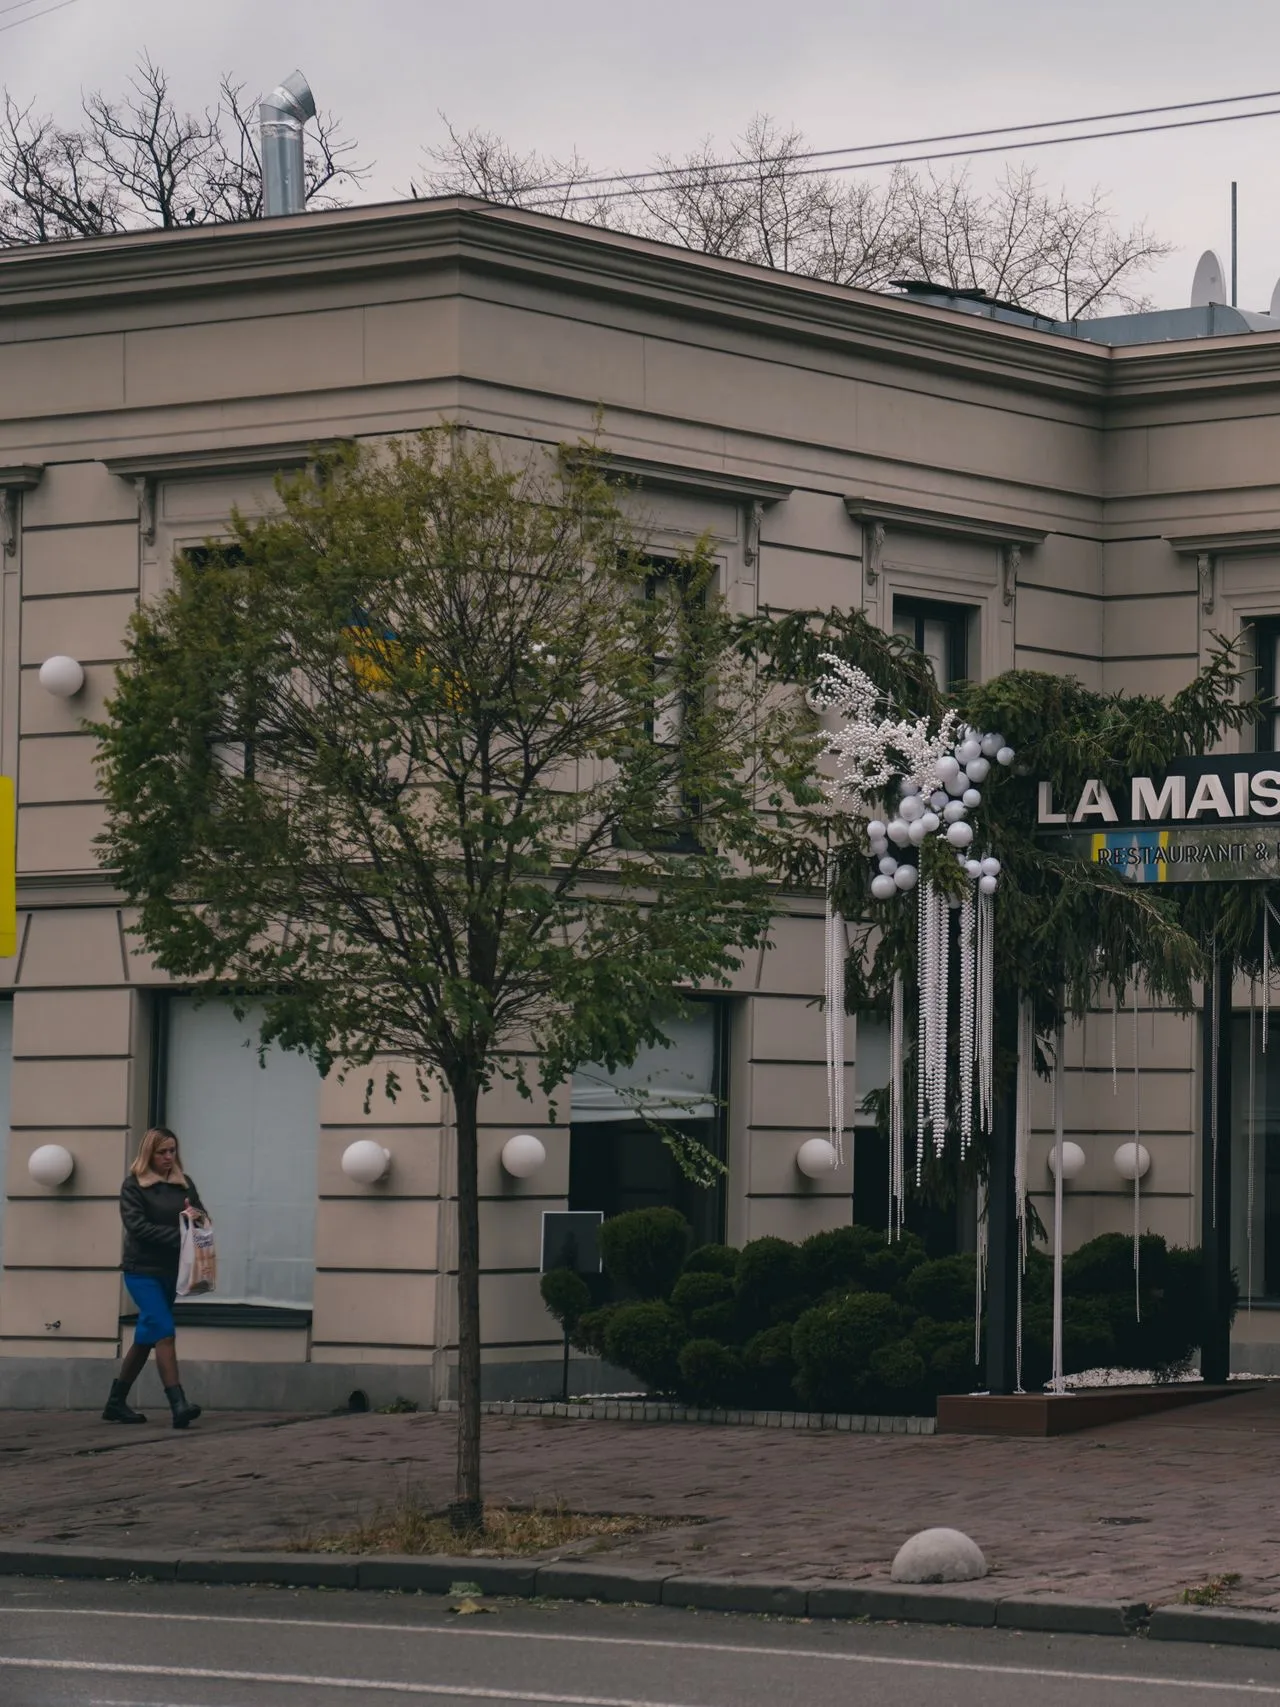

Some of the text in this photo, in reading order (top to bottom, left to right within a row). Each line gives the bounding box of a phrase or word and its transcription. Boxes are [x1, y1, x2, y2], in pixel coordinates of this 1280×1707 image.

[1038, 779, 1119, 823] LA
[1098, 843, 1247, 865] RESTAURANT
[1255, 841, 1269, 861] &
